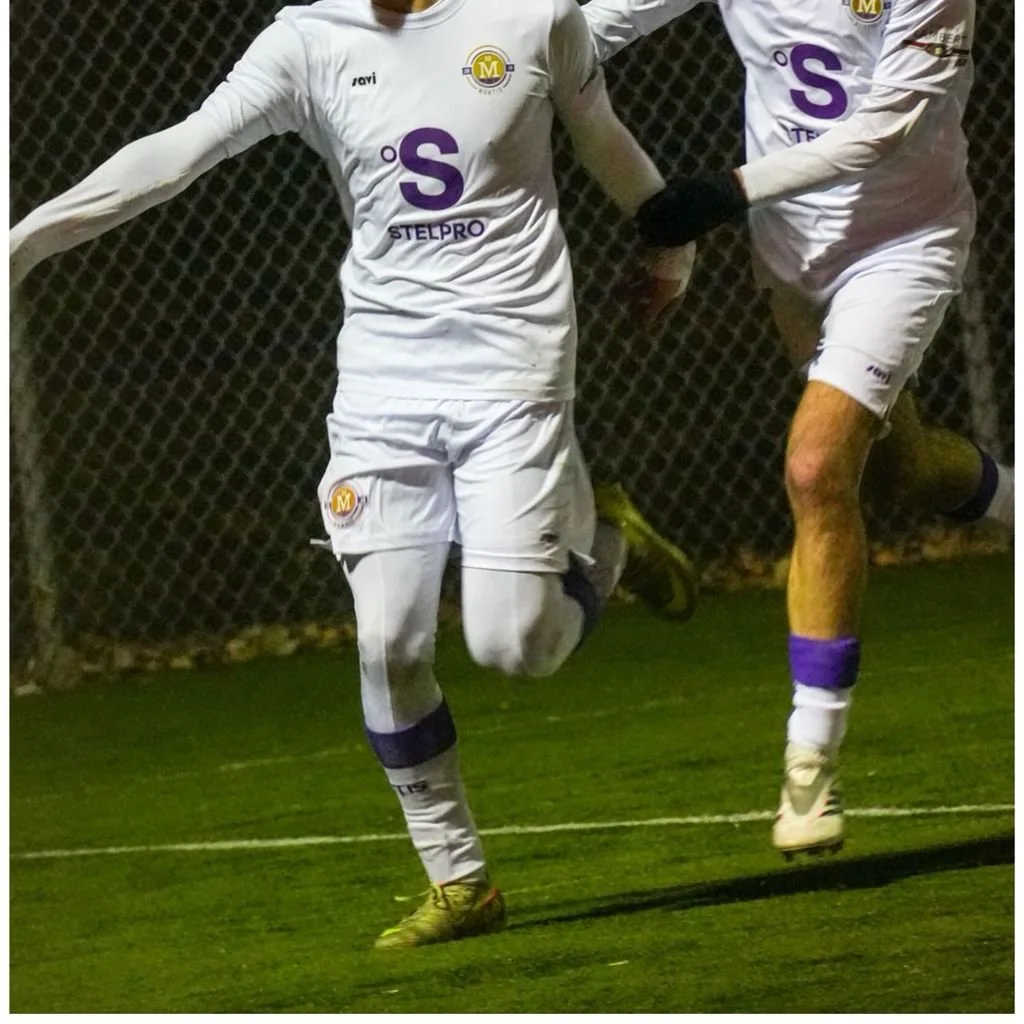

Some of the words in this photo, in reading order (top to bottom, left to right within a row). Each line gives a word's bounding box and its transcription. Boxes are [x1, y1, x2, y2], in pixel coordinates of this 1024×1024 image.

[478, 60, 500, 78] M
[351, 71, 376, 87] savi
[387, 219, 485, 241] STELPRO
